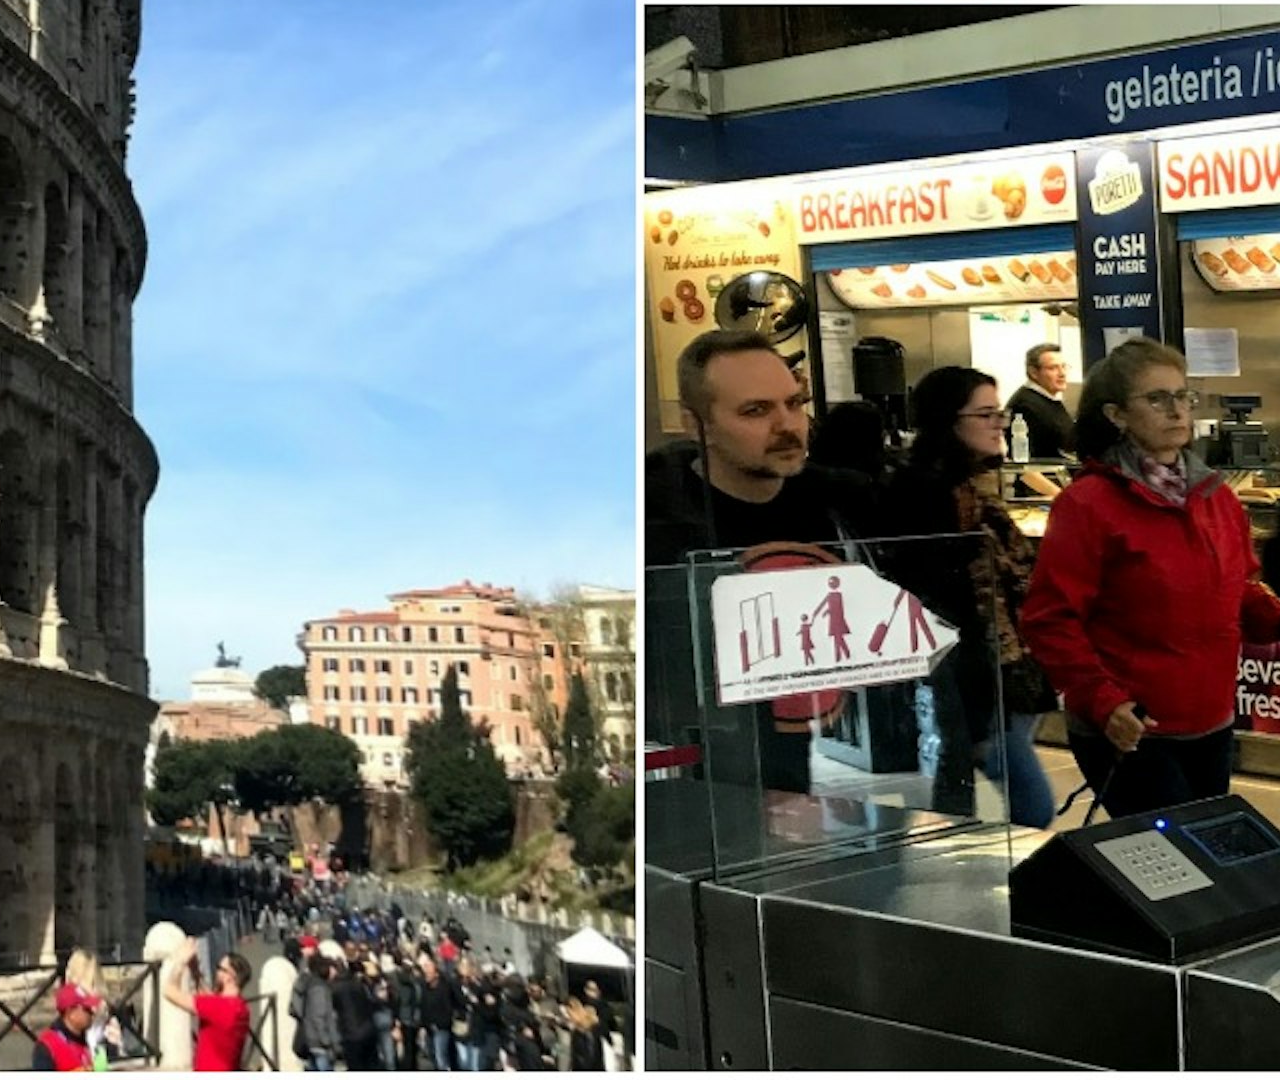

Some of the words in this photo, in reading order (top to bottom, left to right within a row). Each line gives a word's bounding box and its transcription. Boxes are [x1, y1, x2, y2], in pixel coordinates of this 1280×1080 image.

[1105, 56, 1243, 123] gelateria
[800, 179, 951, 232] BREAKFAST
[1093, 233, 1146, 259] CASH
[1095, 262, 1115, 275] PAY
[1117, 259, 1147, 274] HERE
[1093, 295, 1120, 309] TAKE
[1122, 293, 1151, 308] AWAY
